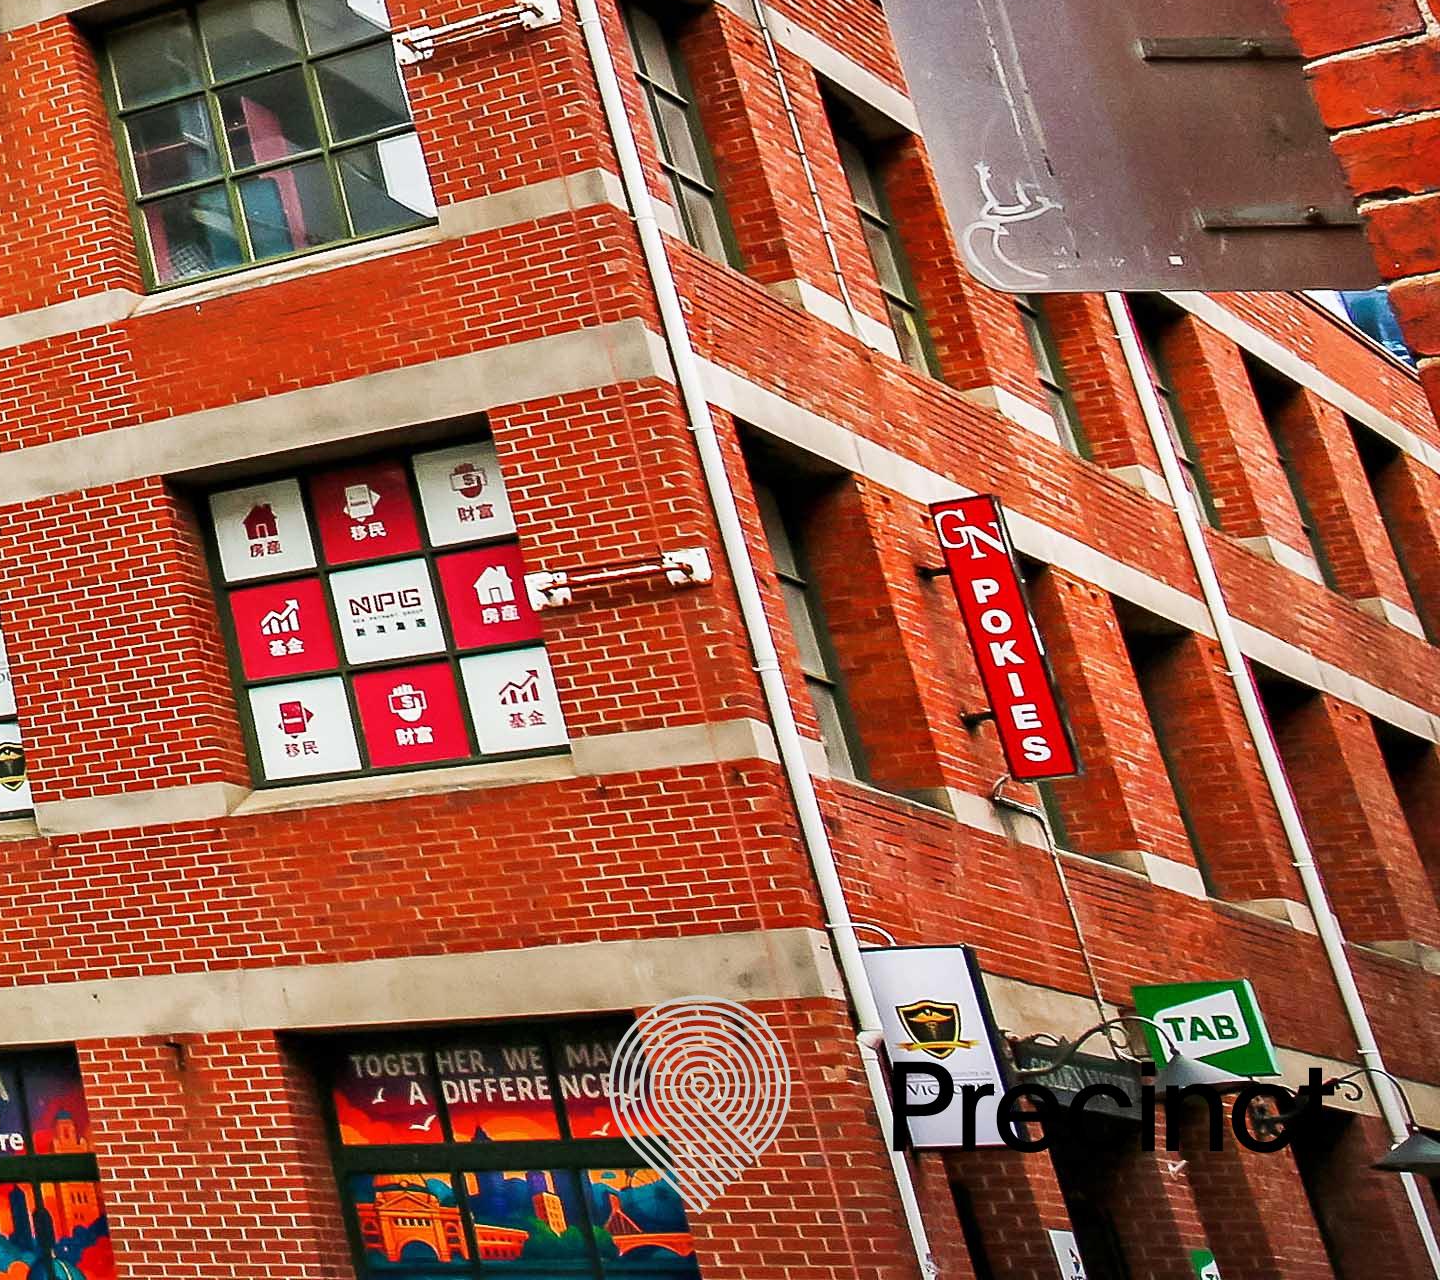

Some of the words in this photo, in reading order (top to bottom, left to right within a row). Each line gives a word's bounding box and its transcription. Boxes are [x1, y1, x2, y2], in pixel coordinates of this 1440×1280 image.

[457, 504, 494, 523] 財富
[350, 521, 387, 541] 移民
[934, 509, 1007, 559] GN
[348, 588, 422, 615] NPG
[268, 637, 305, 657] 基金
[971, 578, 1052, 762] POKIES
[508, 710, 547, 728] 基金
[394, 726, 434, 746] 財富
[284, 740, 320, 757] 移民
[1162, 1013, 1240, 1044] TAB
[502, 1046, 544, 1072] WE
[408, 1082, 428, 1105] A
